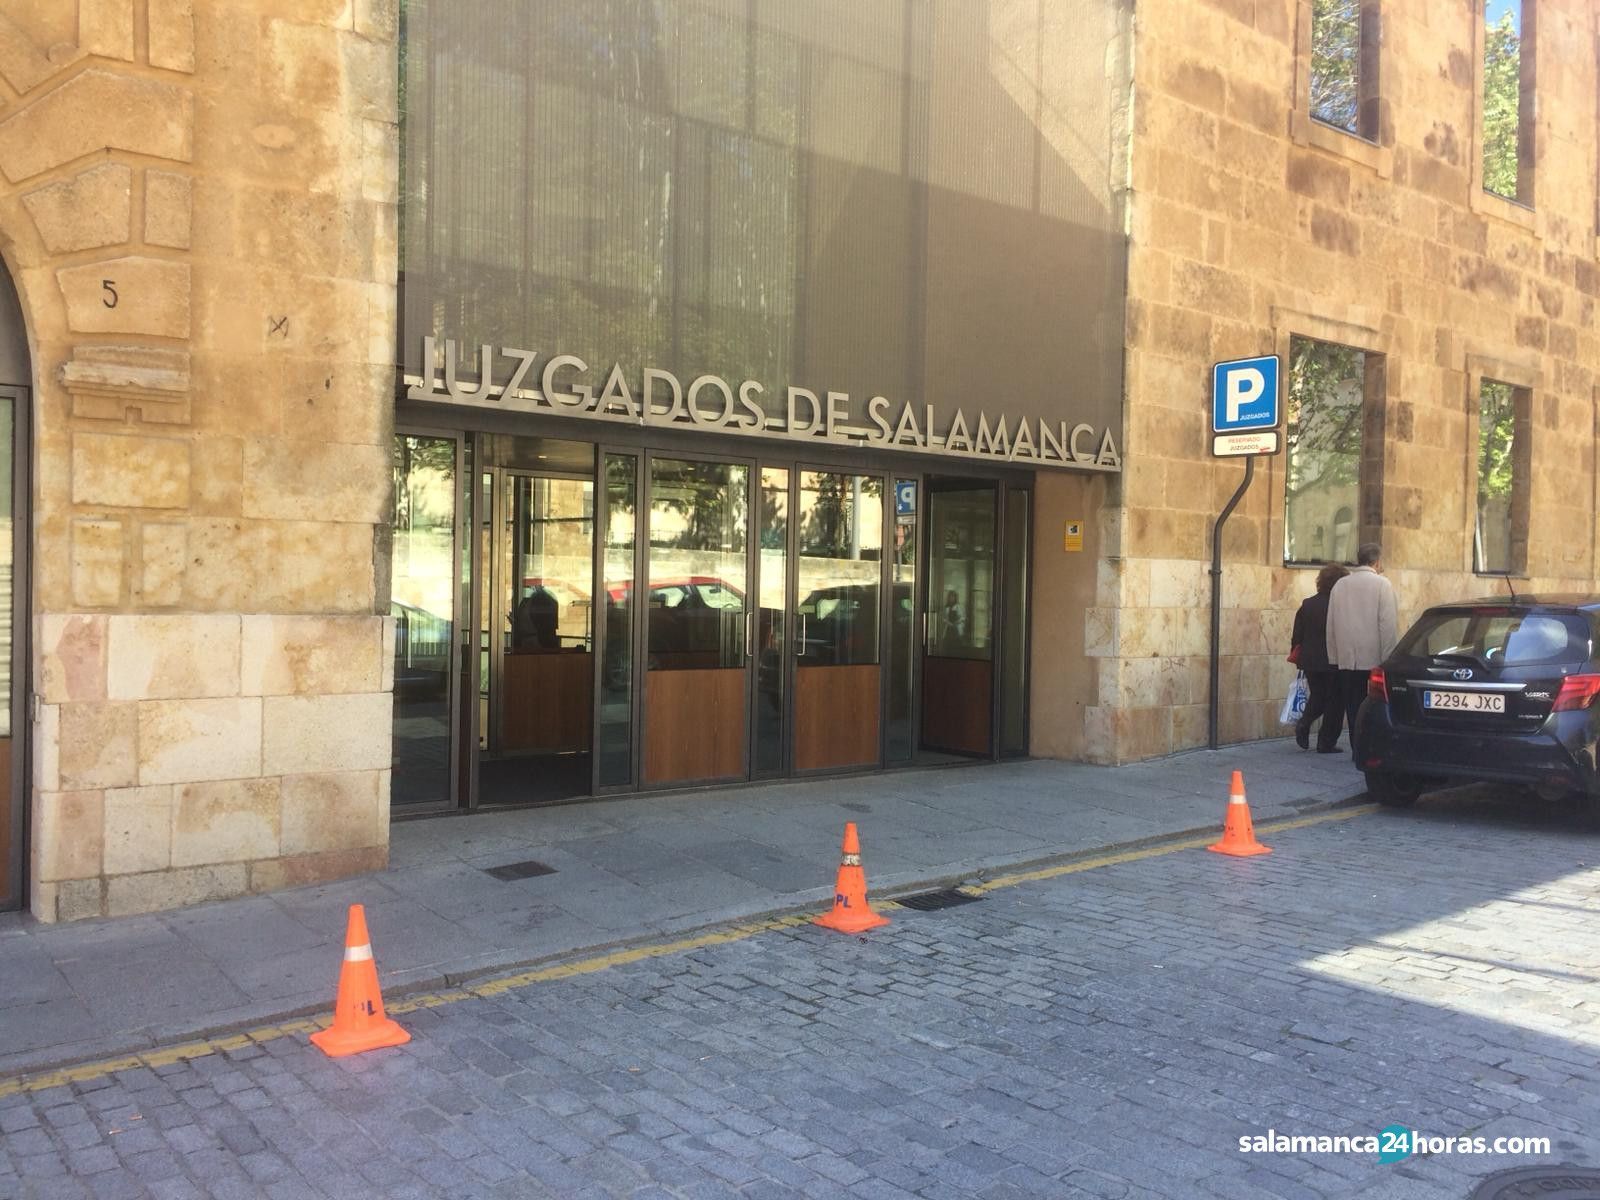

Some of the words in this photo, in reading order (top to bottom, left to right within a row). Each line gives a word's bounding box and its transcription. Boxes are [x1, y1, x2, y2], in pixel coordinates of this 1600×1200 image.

[102, 279, 119, 309] 5
[407, 335, 765, 431] JUZGADOS
[787, 385, 850, 440] DE
[866, 396, 1121, 467] SALAMANCA
[1226, 368, 1264, 421] P
[1240, 412, 1270, 420] JUZGADOS
[1434, 694, 1469, 709] 2294
[1474, 695, 1502, 710] JXC
